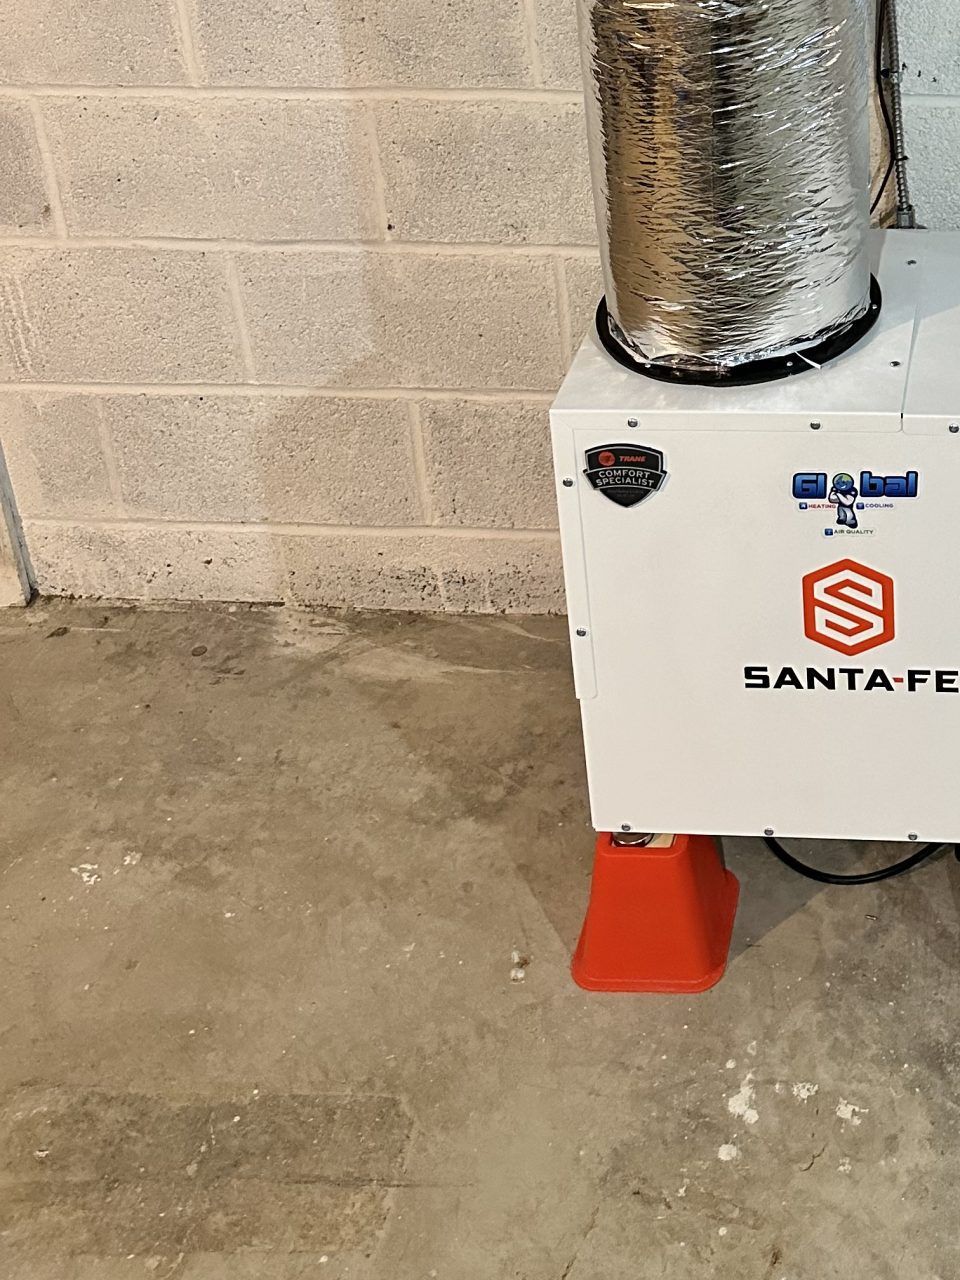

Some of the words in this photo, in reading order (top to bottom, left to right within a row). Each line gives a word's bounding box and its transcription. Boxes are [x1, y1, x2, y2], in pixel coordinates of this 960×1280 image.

[598, 469, 650, 479] COMFORT
[595, 477, 655, 487] SPECIALIST
[744, 666, 959, 693] SANTA-FE
